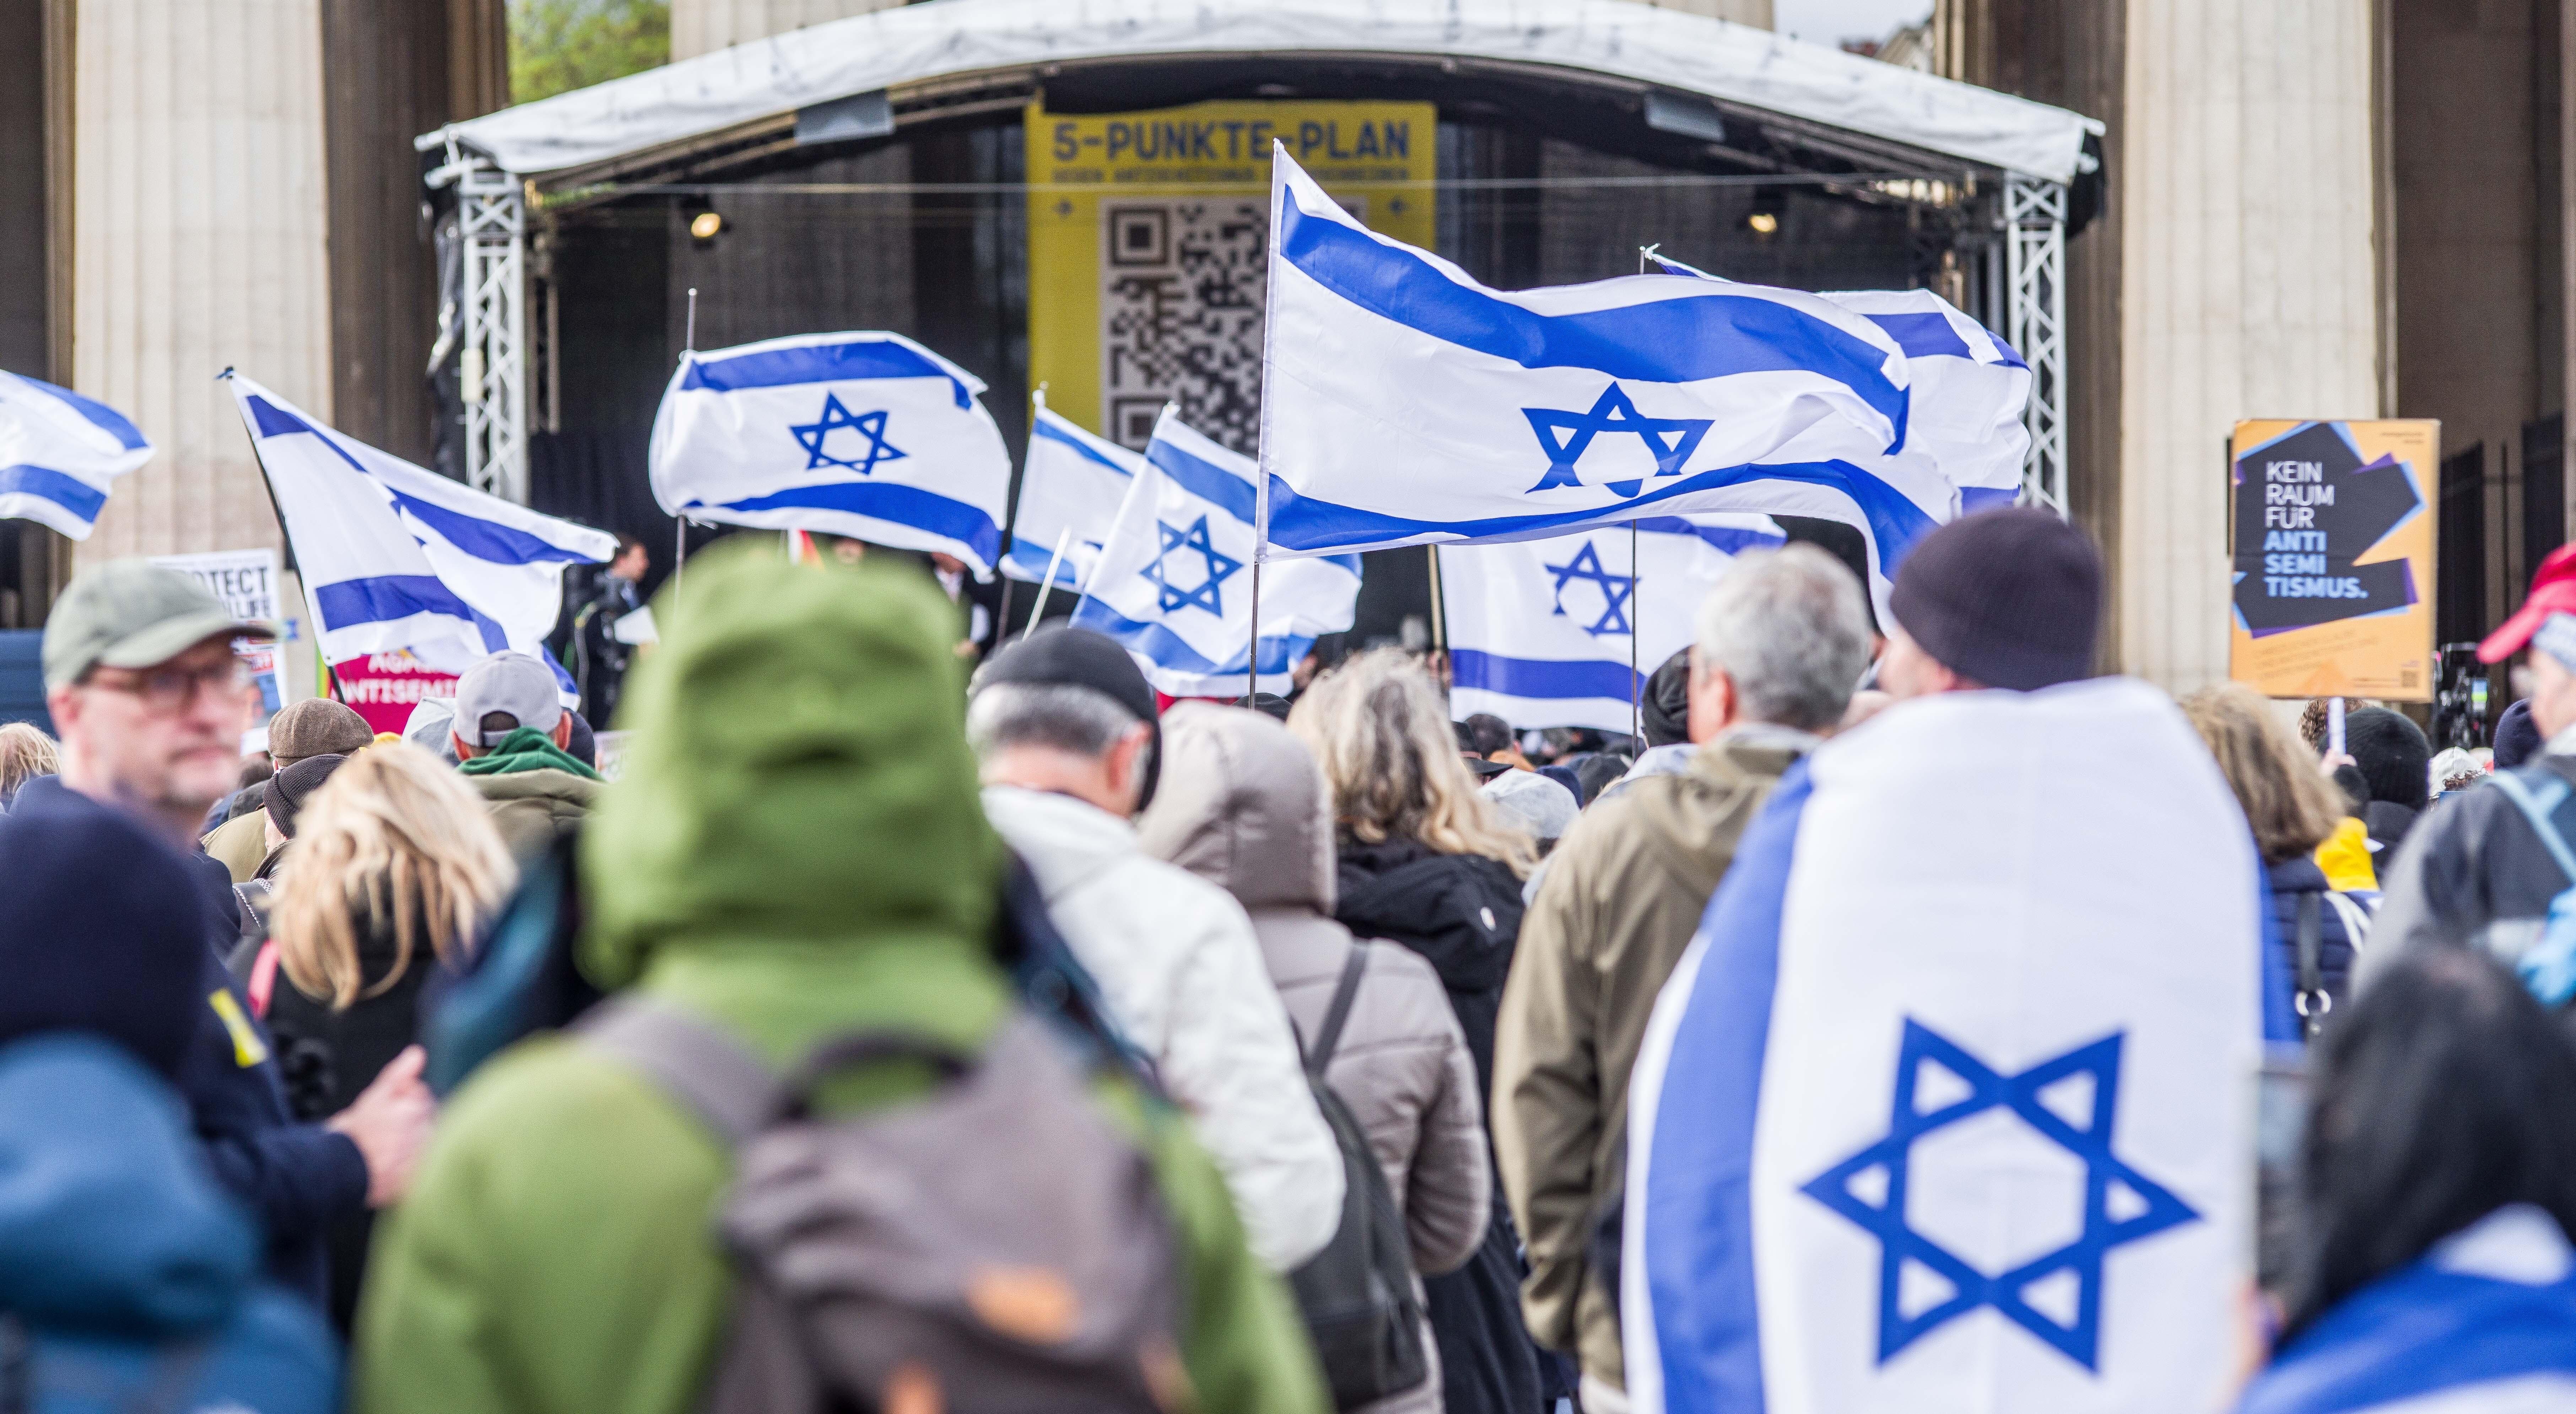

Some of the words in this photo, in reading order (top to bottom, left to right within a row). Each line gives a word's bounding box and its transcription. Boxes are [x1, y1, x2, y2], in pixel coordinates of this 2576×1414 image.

[1053, 121, 1409, 162] 5-PUNKTE-PLAN
[2266, 461, 2322, 482] KEIN
[2266, 483, 2335, 506] RAUM
[2266, 506, 2315, 529] FÜR
[2263, 531, 2327, 551] ANTI
[2264, 554, 2327, 574] SEMI
[2263, 576, 2369, 598] TISMUS.
